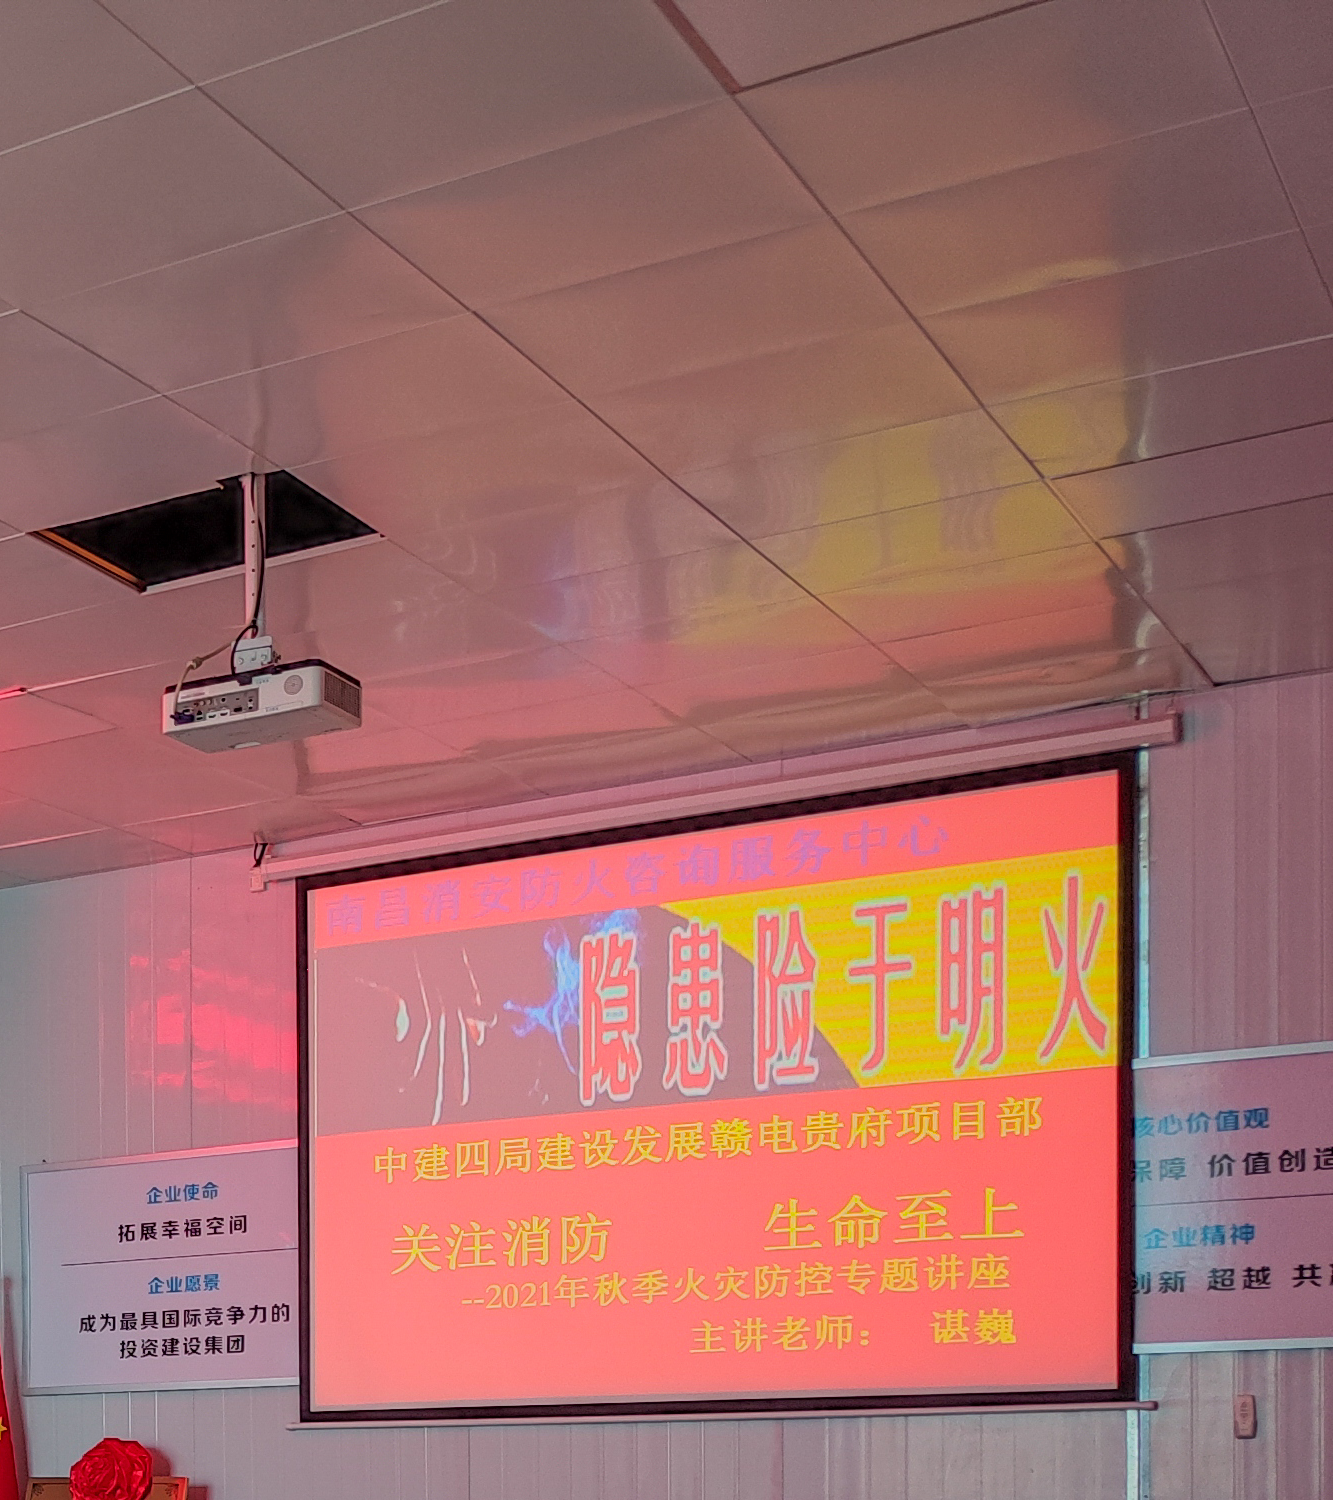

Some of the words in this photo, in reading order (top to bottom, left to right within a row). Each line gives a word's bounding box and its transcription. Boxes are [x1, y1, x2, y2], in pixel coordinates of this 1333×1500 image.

[326, 813, 951, 935] 南昌消安防火咨询服务中心
[577, 867, 1109, 1107] 隐患险于明火
[1132, 1107, 1270, 1139] 核心价值观
[373, 1095, 1042, 1184] 中建四局建设发展赣电贵府项目部
[146, 1181, 220, 1205] 企业使命
[118, 1214, 248, 1243] 拓展幸福空间
[390, 1216, 614, 1274] 关注消防
[763, 1186, 1025, 1254] 生命至上
[1143, 1223, 1257, 1250] 企业精神
[147, 1273, 221, 1295] 企业愿景
[1206, 1266, 1272, 1291] 超越
[1292, 1263, 1333, 1289] 共
[78, 1302, 290, 1334] 成为最具国际竞争力的
[689, 1314, 871, 1354] 主讲老师：
[929, 1308, 1018, 1346] 谌巍
[119, 1334, 246, 1359] 投资建设集团
